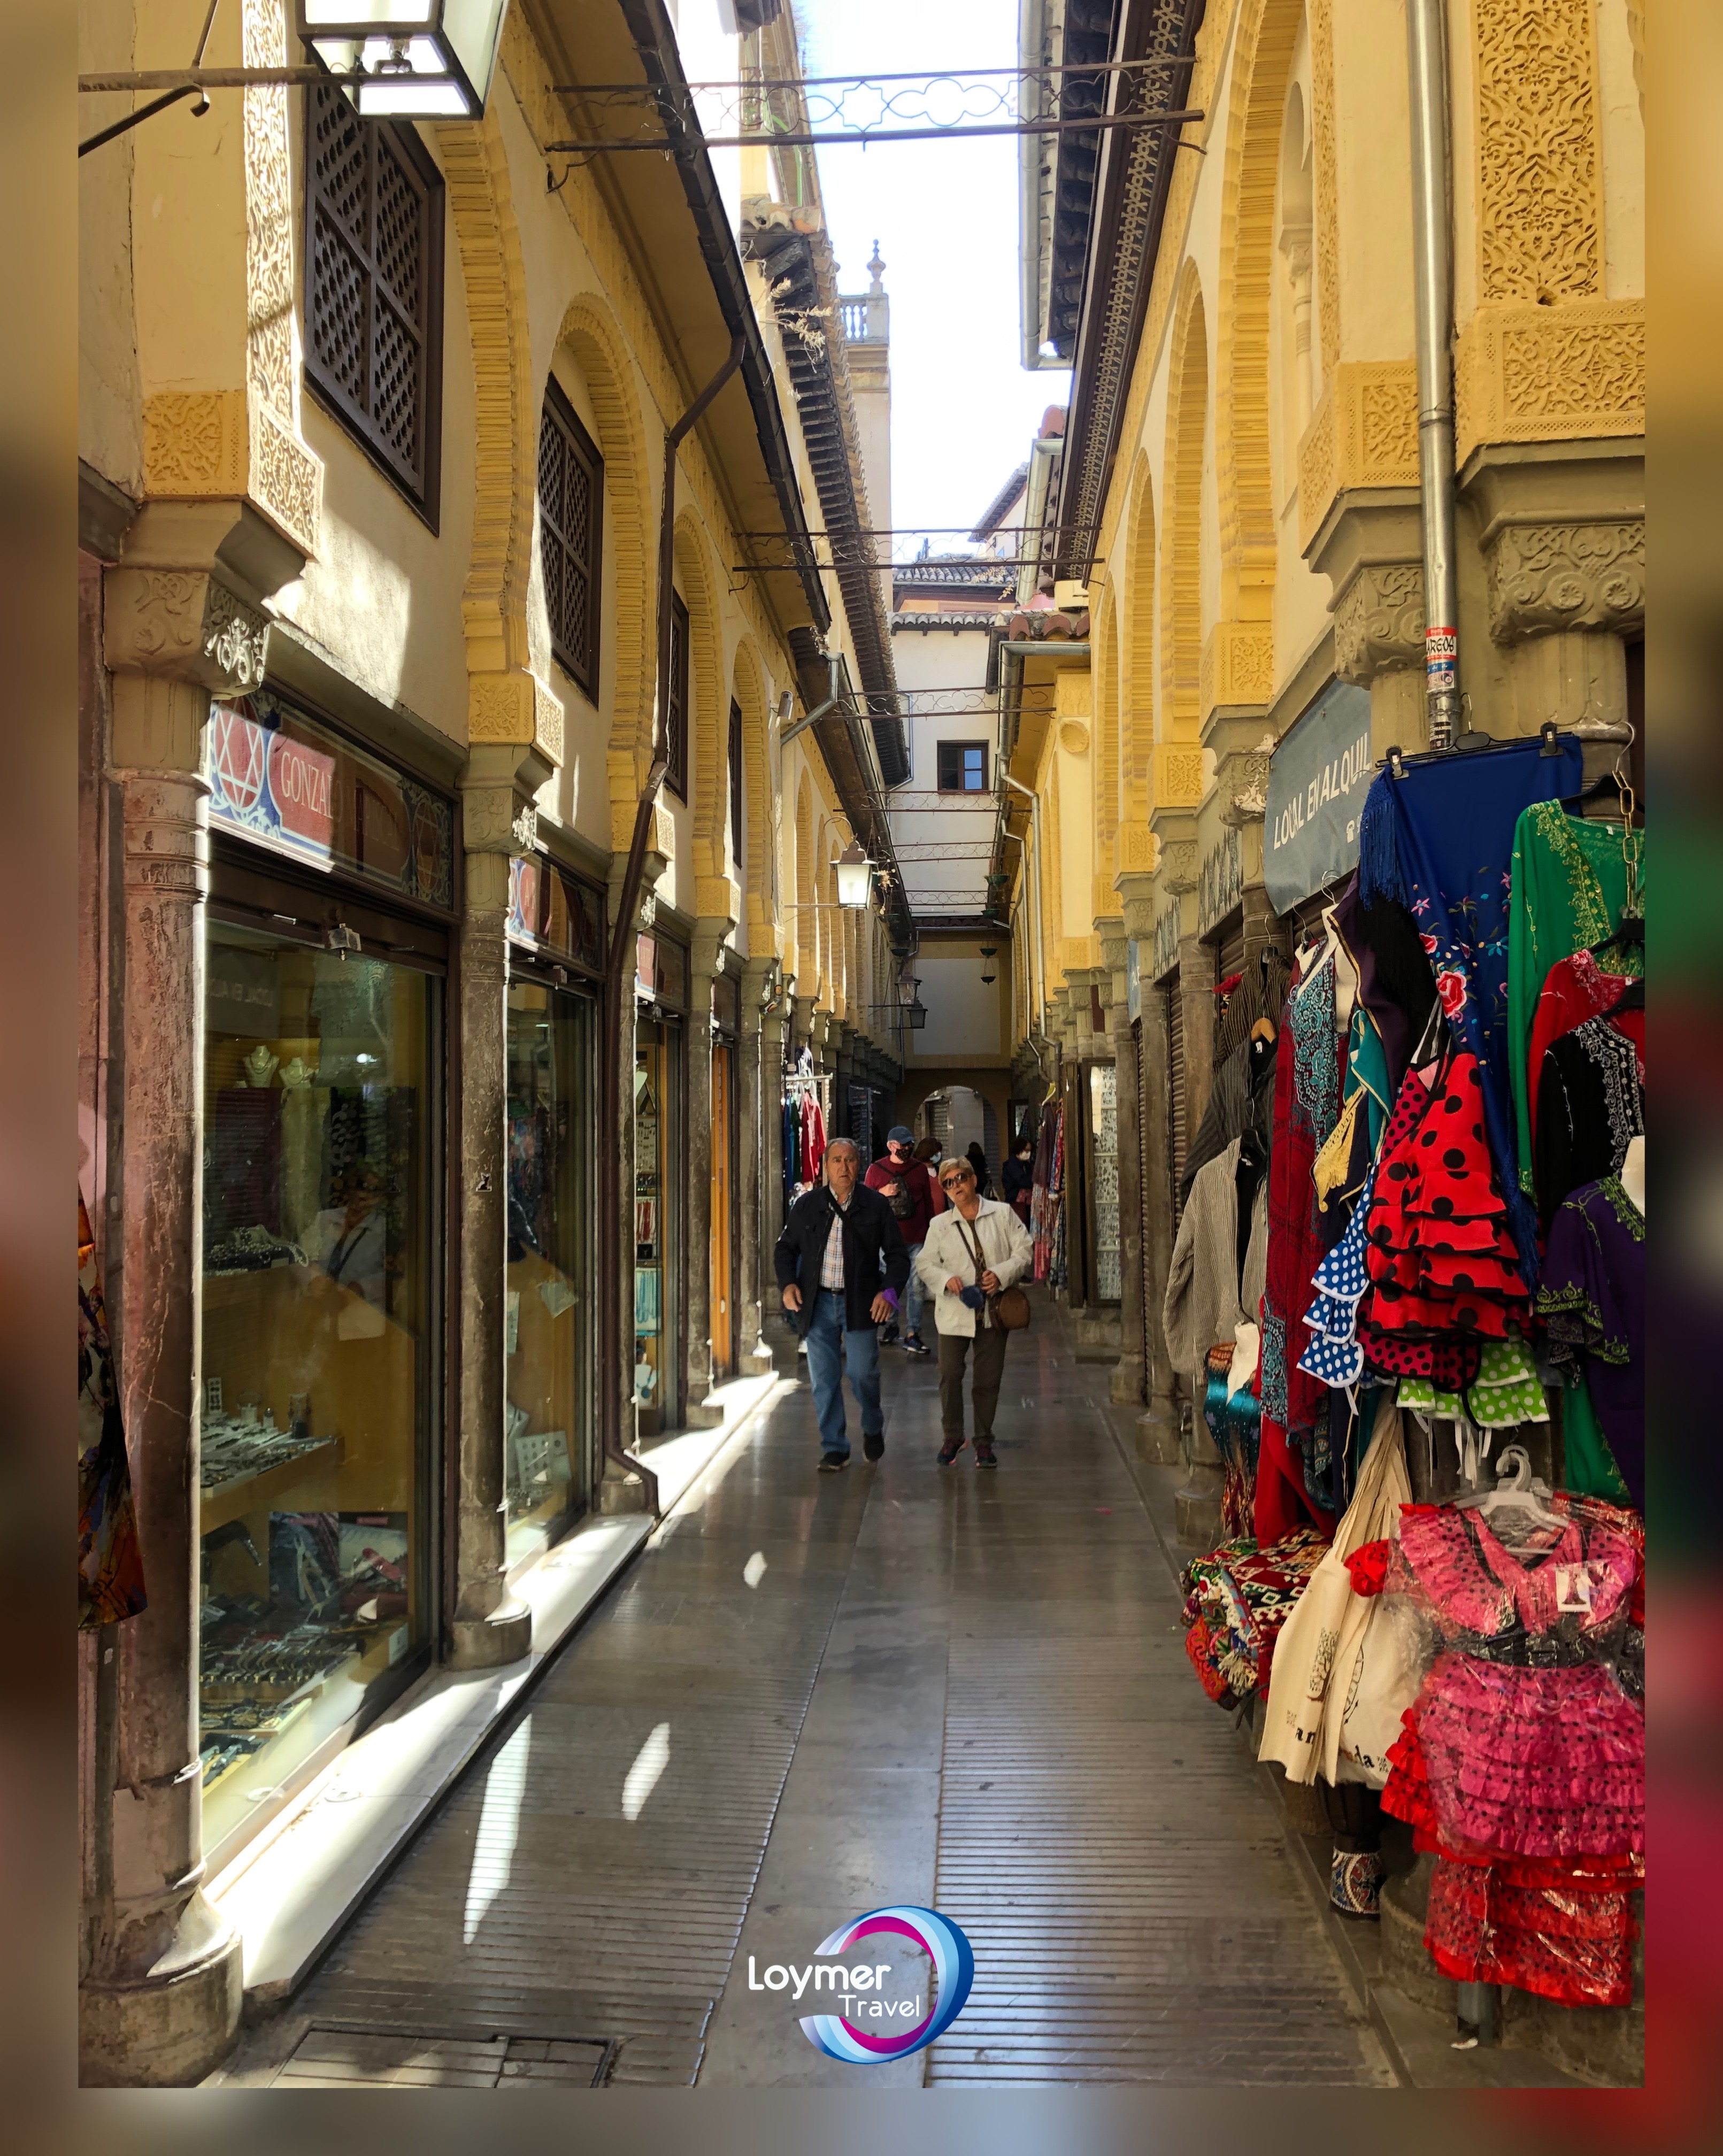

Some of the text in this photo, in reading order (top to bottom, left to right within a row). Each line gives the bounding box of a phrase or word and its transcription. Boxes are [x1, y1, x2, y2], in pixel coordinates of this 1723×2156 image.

[1273, 732, 1372, 850] LOCAL EN ALQUIL
